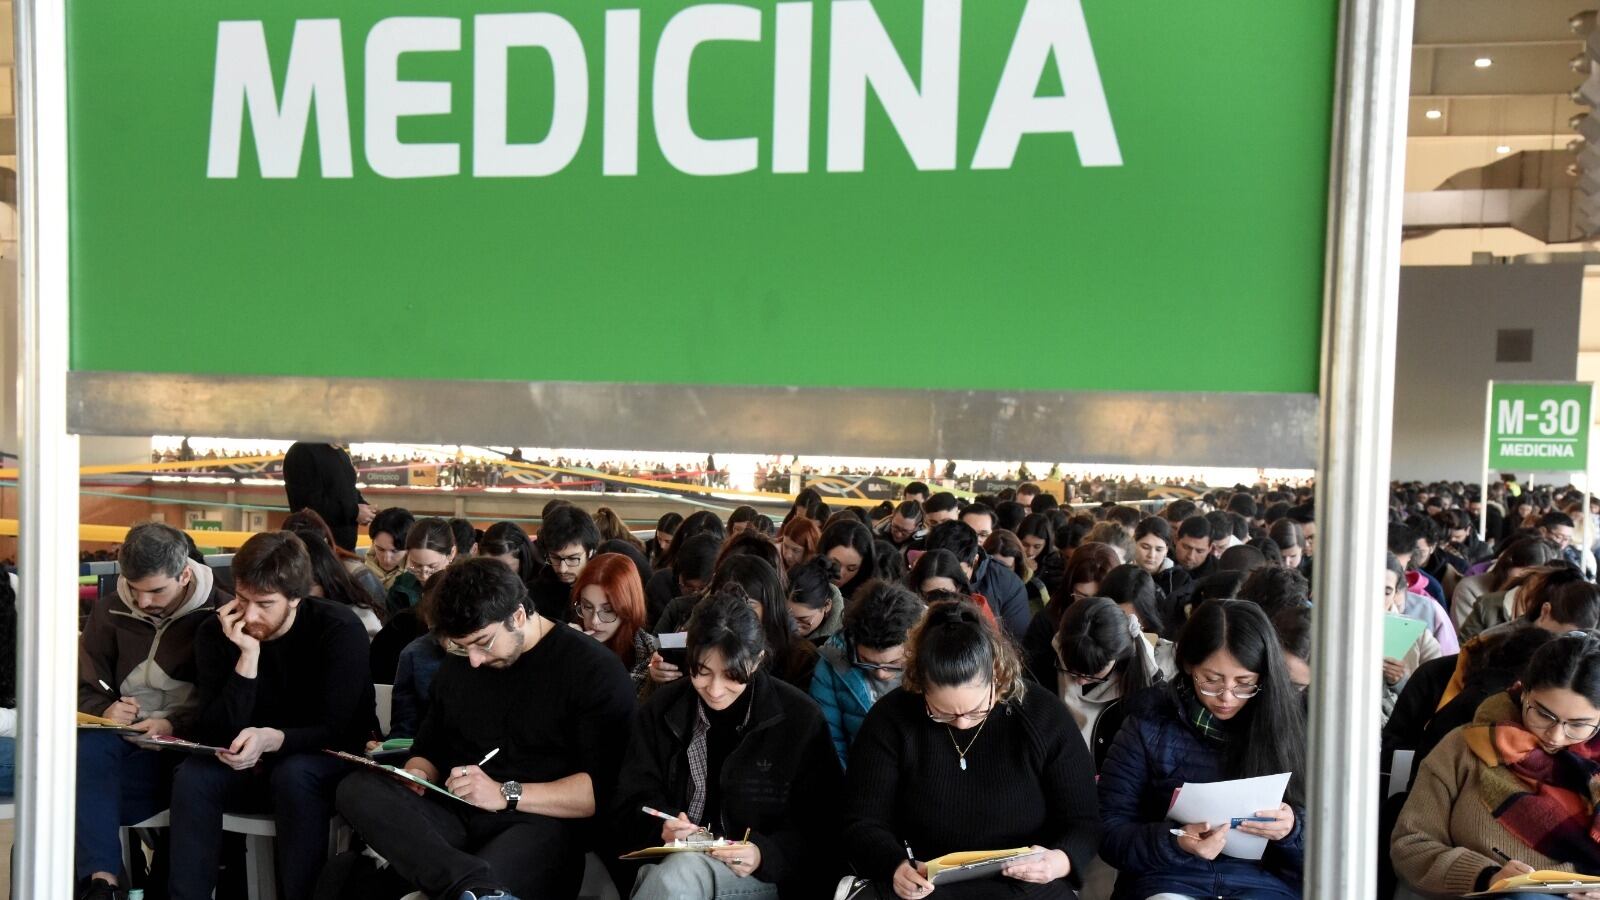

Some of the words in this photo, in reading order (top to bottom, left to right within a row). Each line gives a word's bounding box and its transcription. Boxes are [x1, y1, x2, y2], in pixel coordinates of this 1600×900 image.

[207, 0, 1123, 178] MEDICINA
[1497, 399, 1581, 436] M-30
[1500, 443, 1575, 458] MEDICINA
